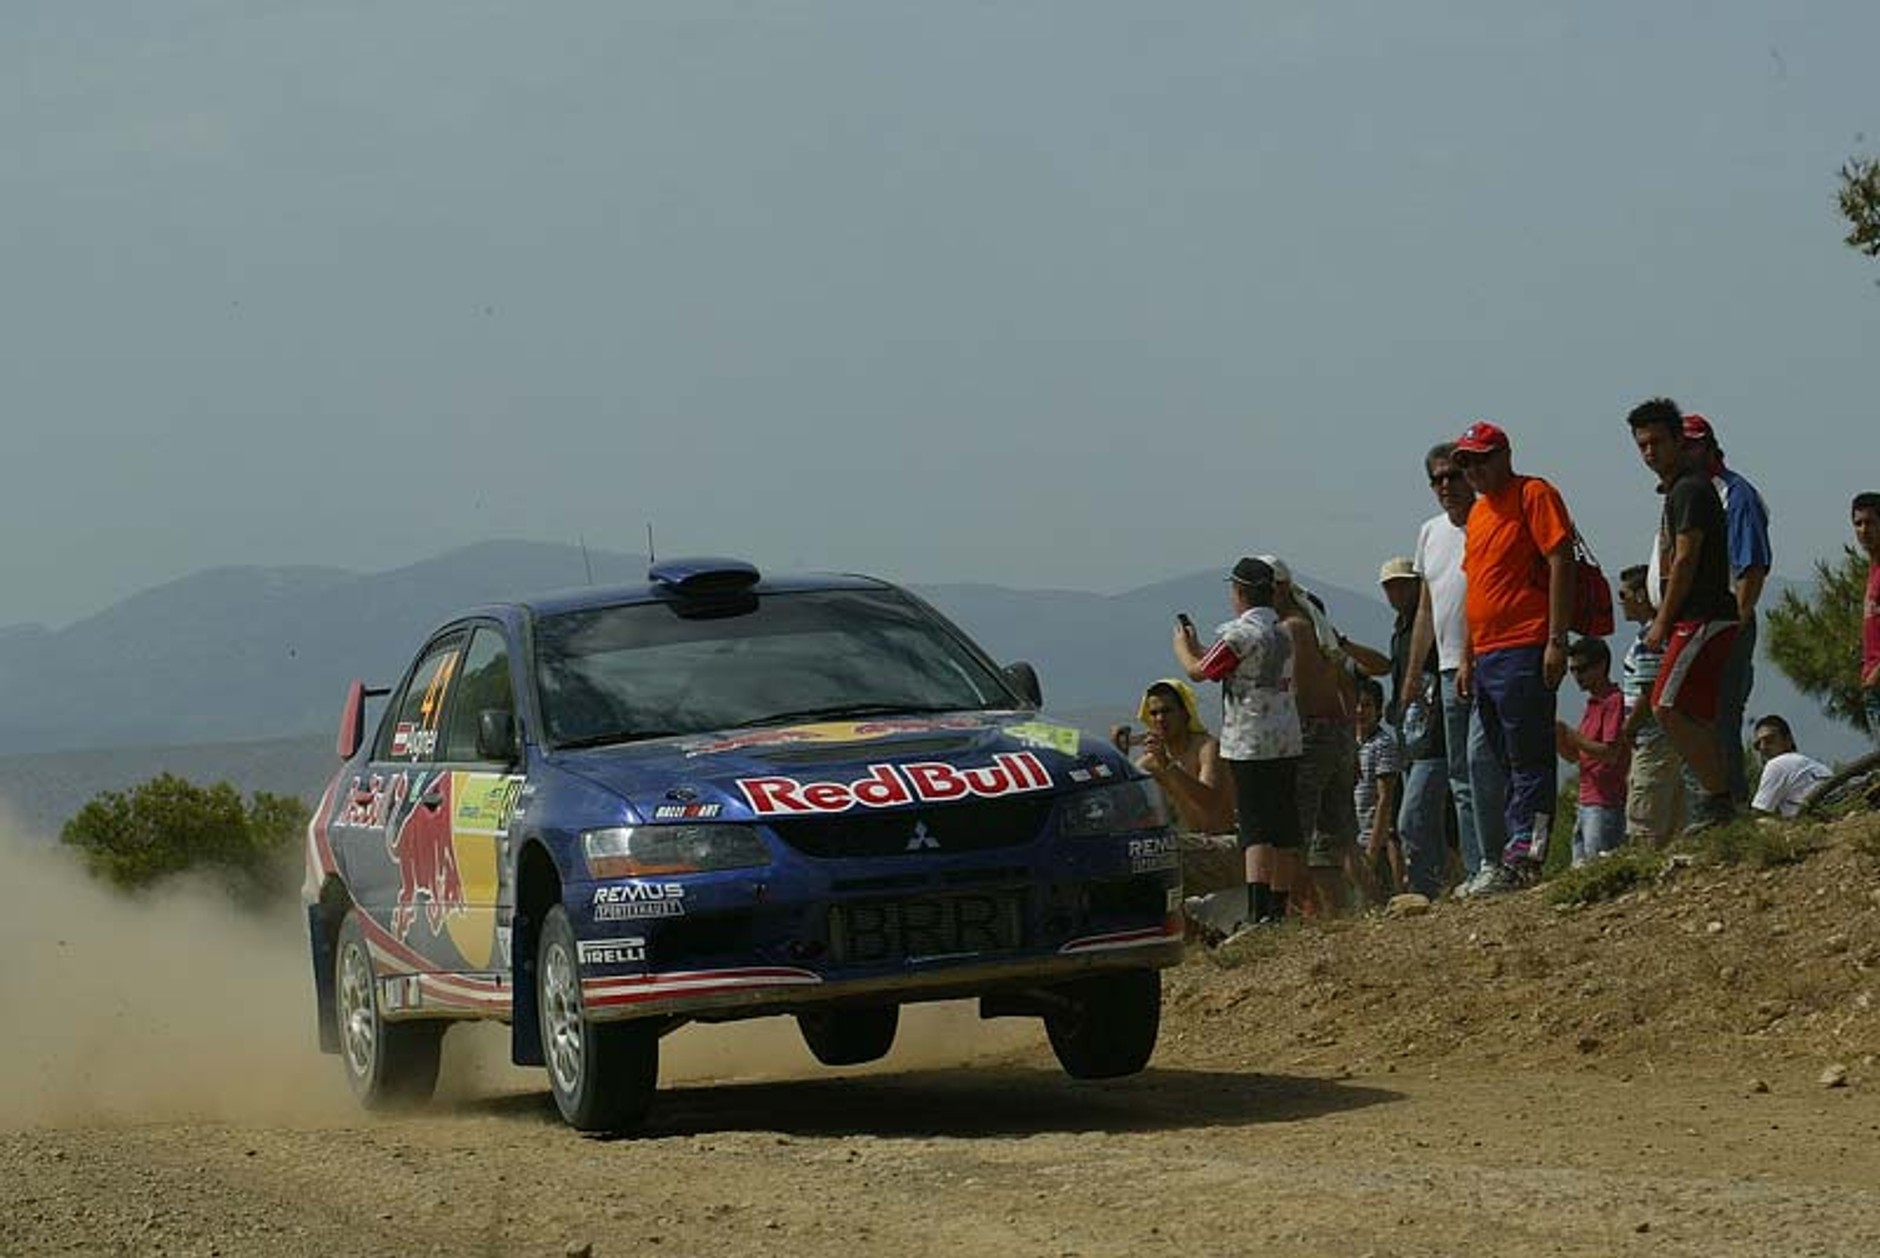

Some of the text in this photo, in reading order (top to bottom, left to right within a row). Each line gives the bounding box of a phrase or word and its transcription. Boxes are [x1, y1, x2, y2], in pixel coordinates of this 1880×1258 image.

[737, 752, 1053, 814] Red Bull
[593, 883, 685, 904] REMUS
[577, 937, 646, 964] PIRELLI
